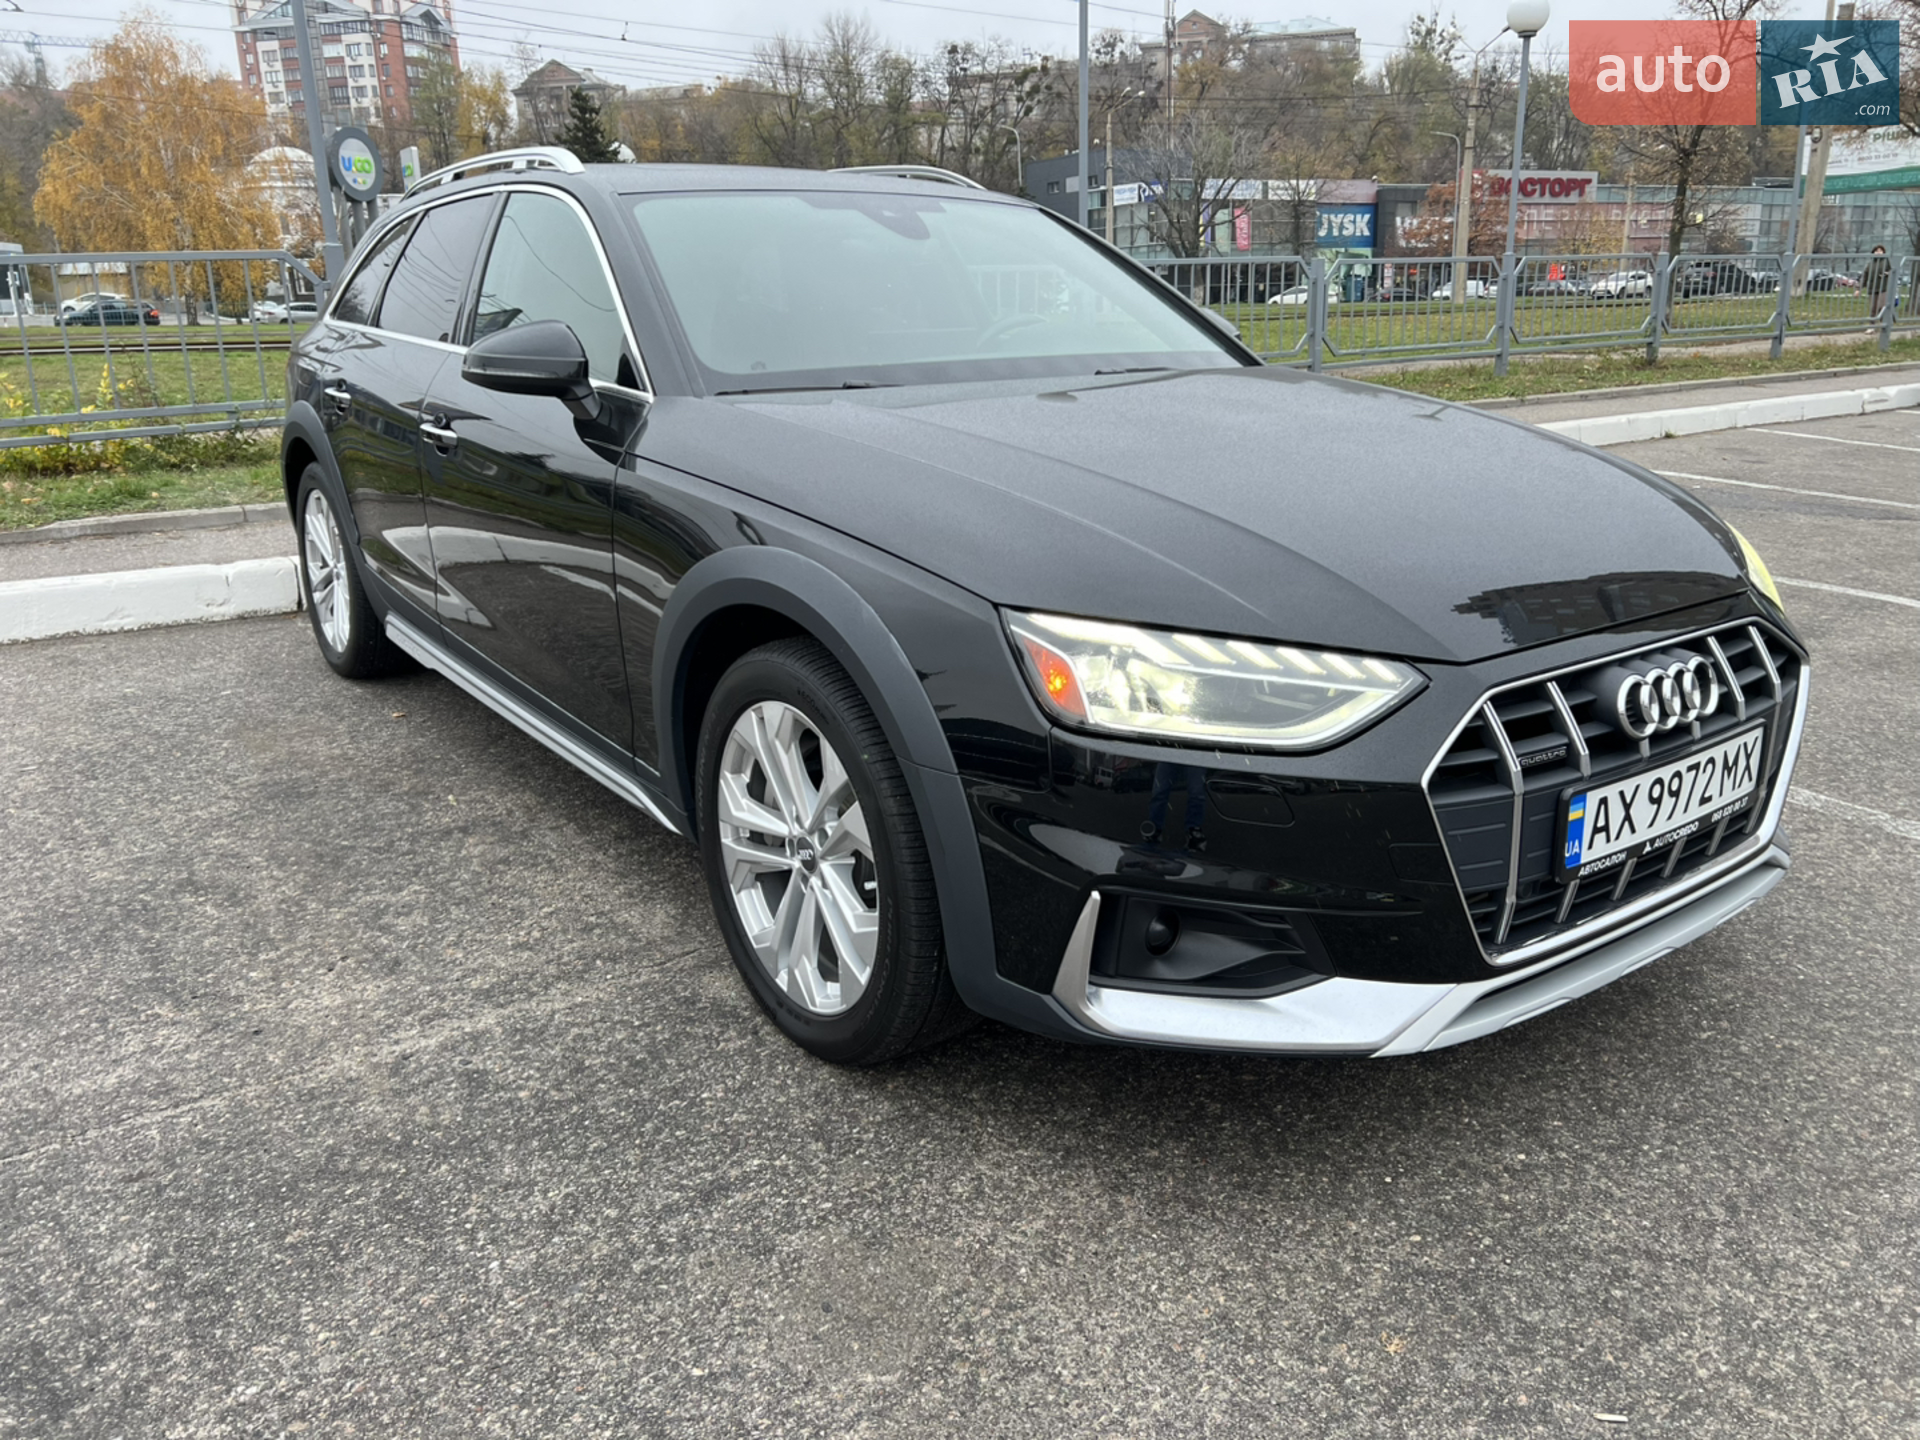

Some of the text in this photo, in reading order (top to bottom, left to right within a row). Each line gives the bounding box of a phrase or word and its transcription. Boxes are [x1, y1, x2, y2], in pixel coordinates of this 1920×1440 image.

[1317, 212, 1372, 238] JYSK
[1587, 735, 1760, 852] AX 9972 MX
[1652, 820, 1700, 849] AUTOCREDO
[1564, 838, 1581, 859] UA
[1578, 851, 1628, 877] АВТОСАЛОН
